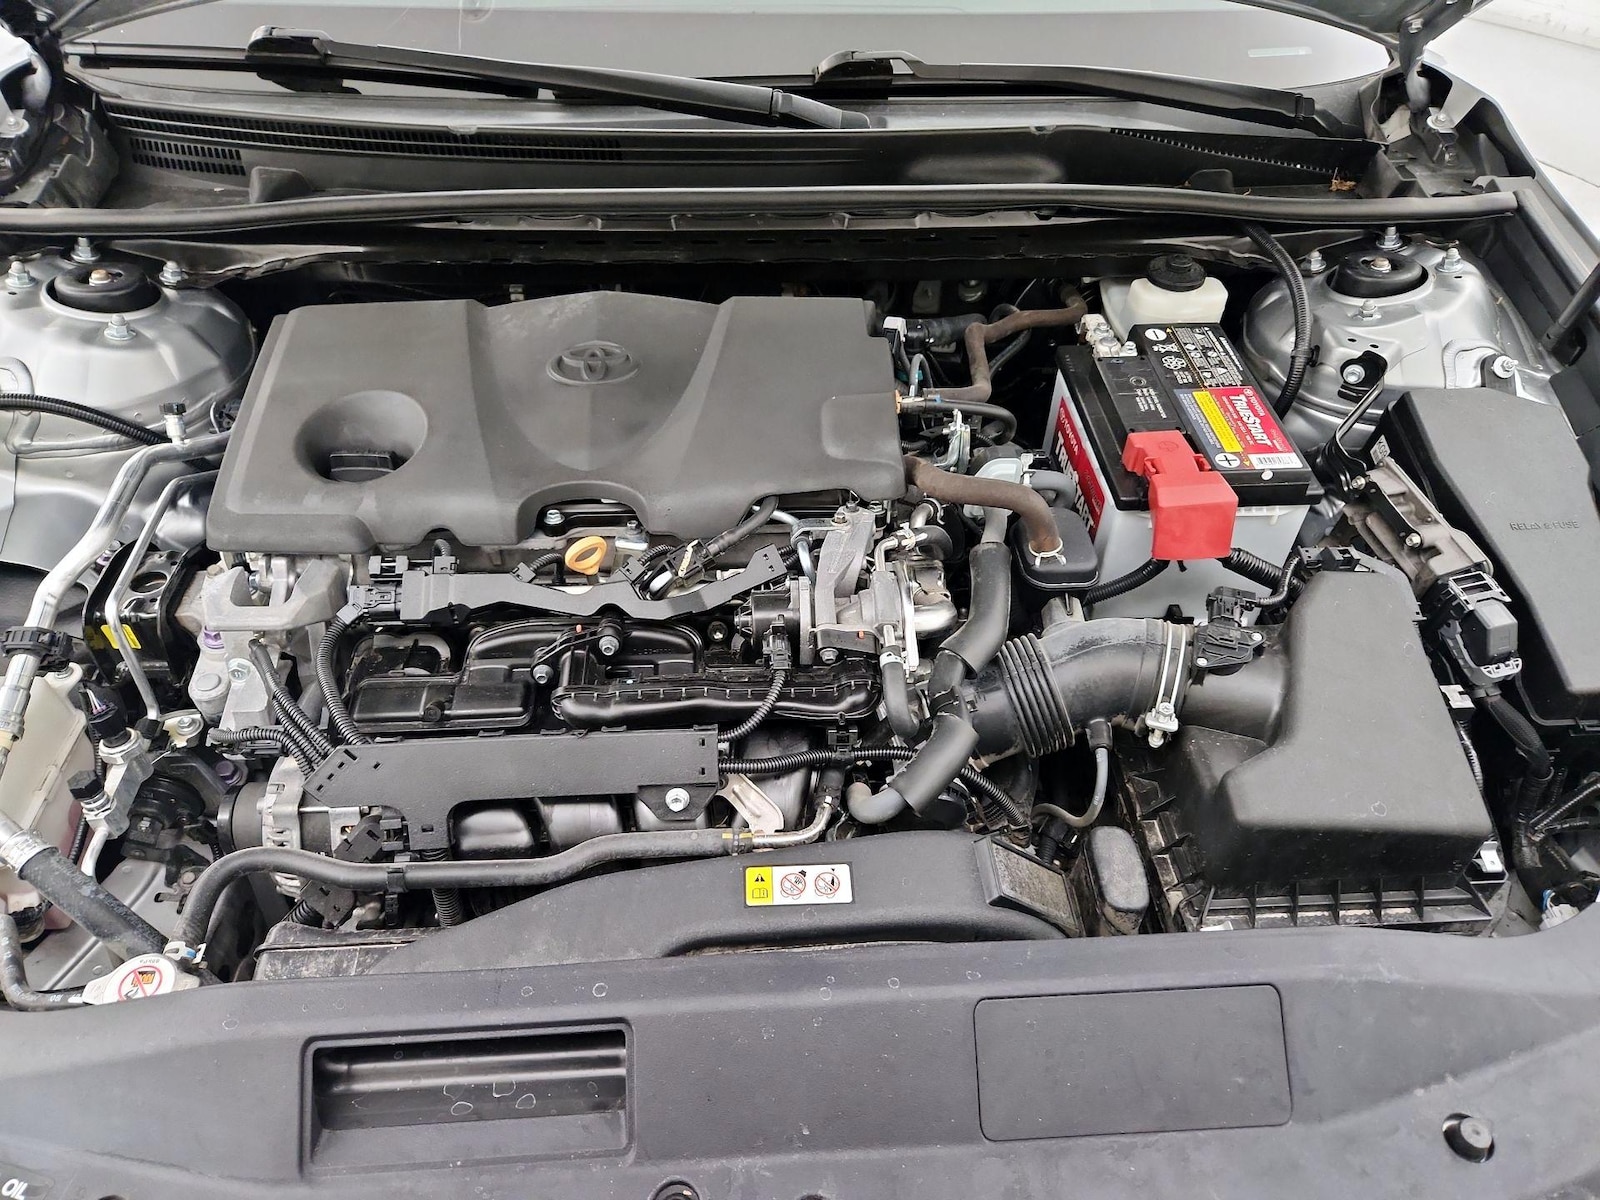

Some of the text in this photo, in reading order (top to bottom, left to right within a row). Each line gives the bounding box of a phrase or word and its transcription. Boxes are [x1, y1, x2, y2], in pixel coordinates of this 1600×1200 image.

[1249, 395, 1266, 417] TOYOTA
[1509, 521, 1542, 531] RELAY
[1553, 520, 1580, 530] FUSE
[1, 1178, 28, 1200] OIL
